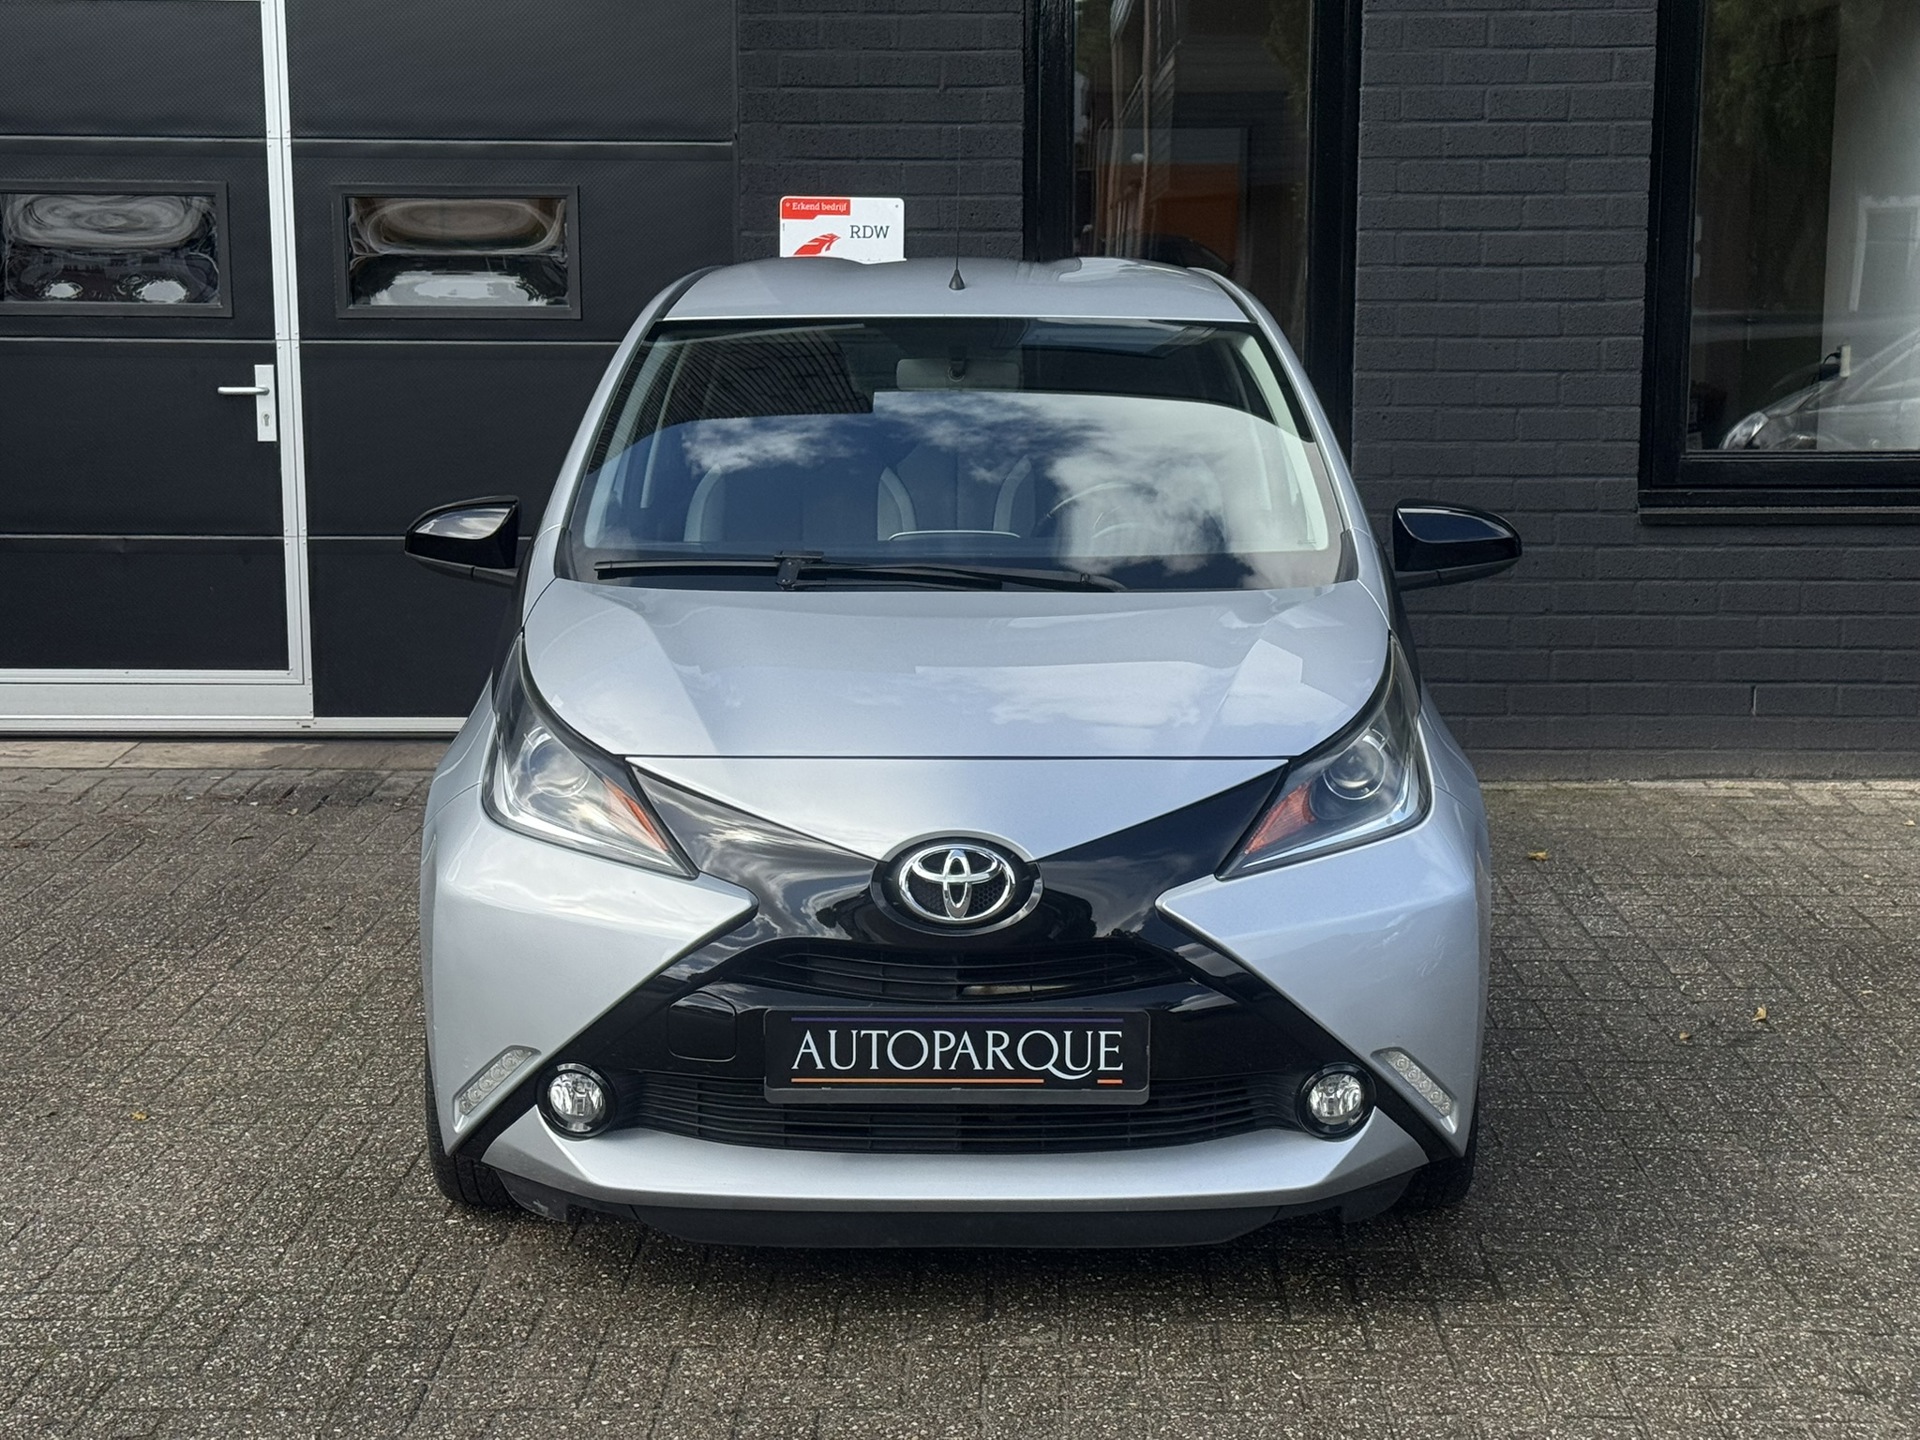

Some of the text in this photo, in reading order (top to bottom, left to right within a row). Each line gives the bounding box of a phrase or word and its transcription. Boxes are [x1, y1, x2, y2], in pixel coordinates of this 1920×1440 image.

[792, 202, 847, 213] Erkend bedrijf
[850, 225, 890, 239] RDW
[791, 1029, 1123, 1080] AUTOPARQUE
